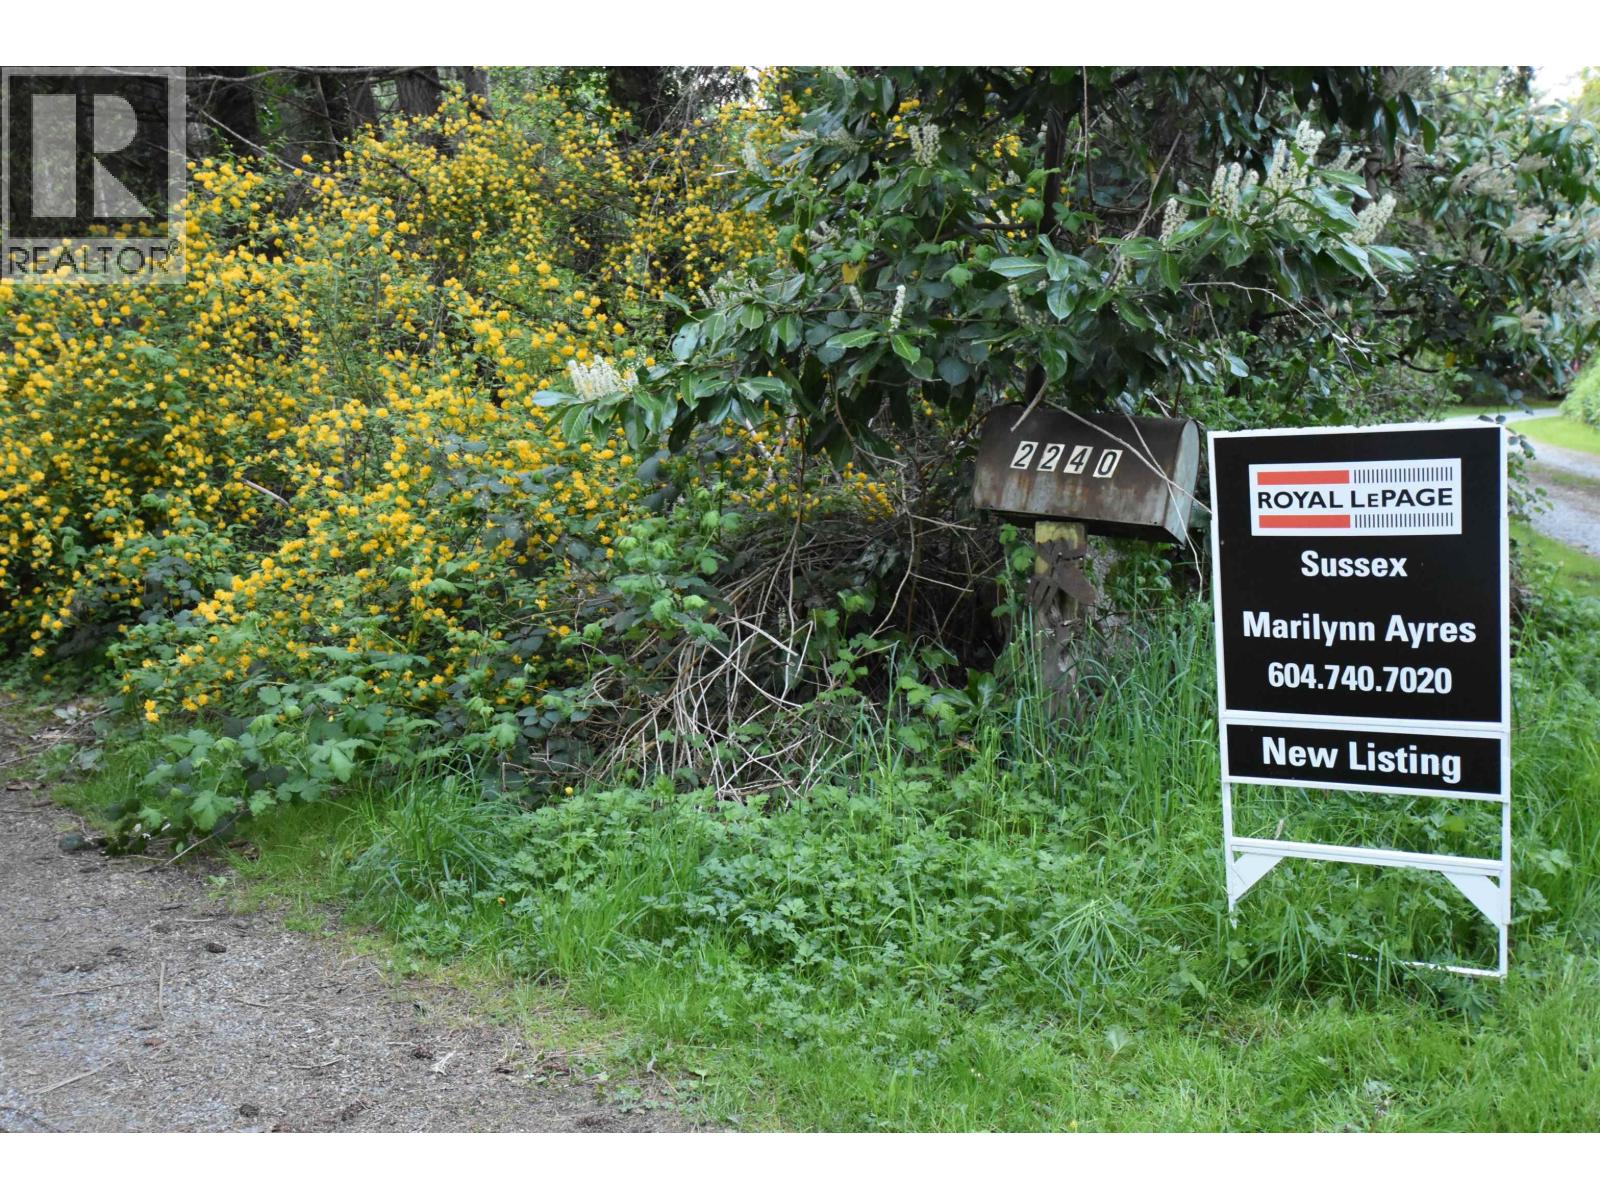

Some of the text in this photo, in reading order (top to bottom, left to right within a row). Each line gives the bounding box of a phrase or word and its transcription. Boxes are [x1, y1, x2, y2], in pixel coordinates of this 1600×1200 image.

[1014, 443, 1117, 476] 2240
[1257, 490, 1344, 509] ROYAL
[1300, 550, 1408, 578] Sussex
[1242, 610, 1477, 648] Marilynn Ayres
[1267, 661, 1453, 695] 604.740.7020
[1261, 736, 1461, 784] New Listing
